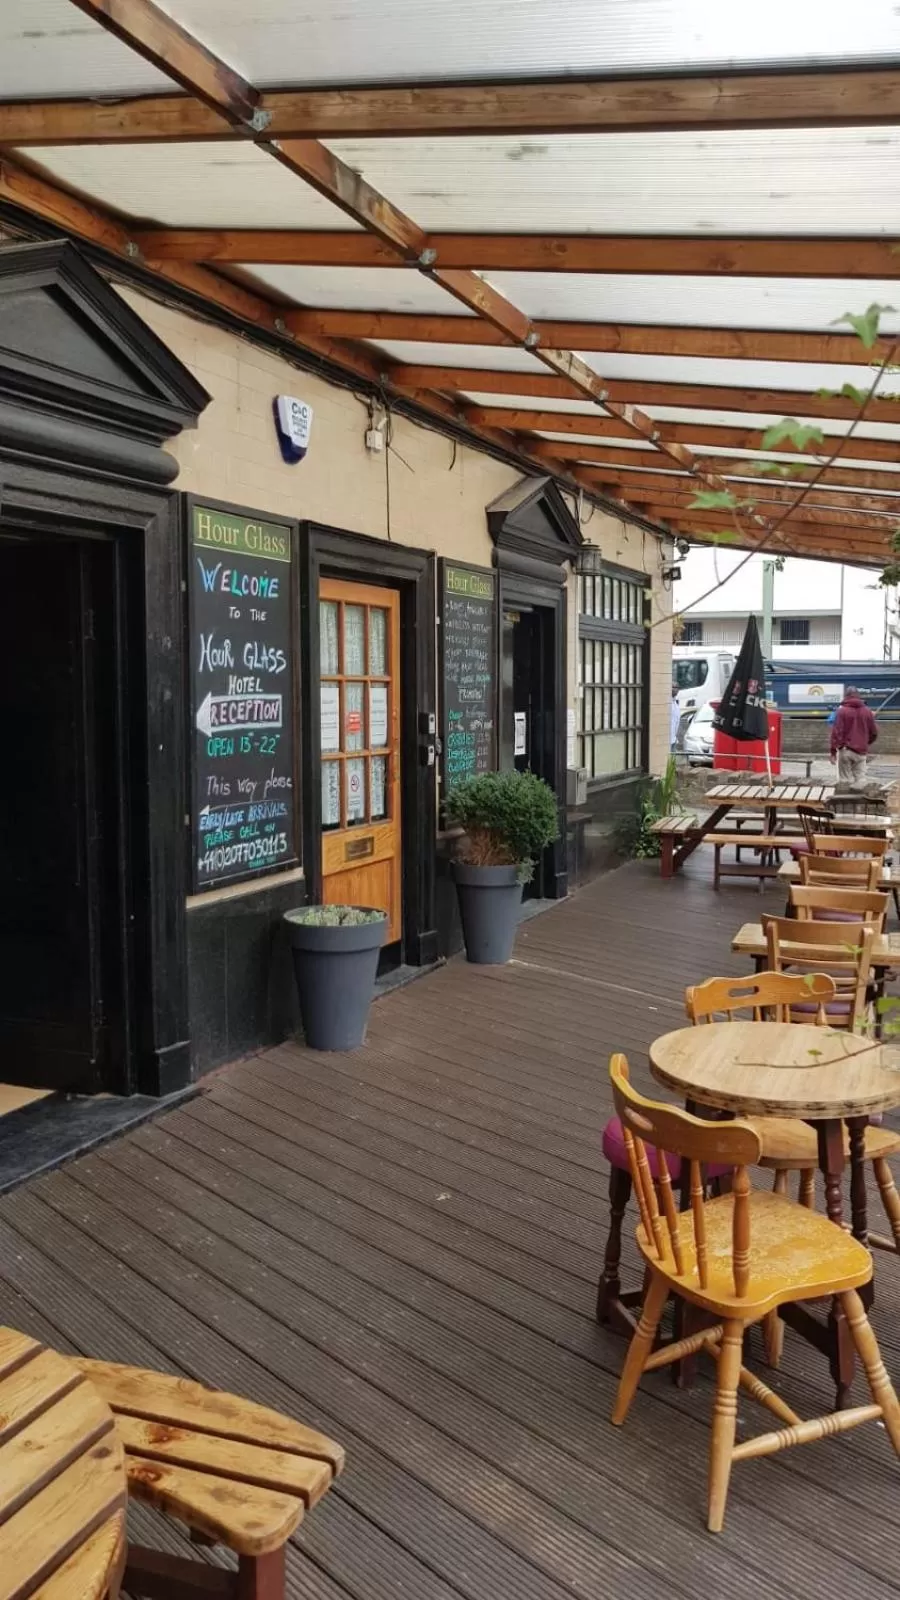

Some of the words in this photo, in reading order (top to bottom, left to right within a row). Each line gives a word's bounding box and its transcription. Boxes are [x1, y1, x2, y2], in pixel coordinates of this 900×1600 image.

[198, 514, 239, 545] Hour
[244, 525, 286, 554] Glass
[197, 557, 280, 598] WELCOME
[447, 570, 468, 592] Hour
[199, 633, 235, 673] HOUR
[243, 642, 287, 674] GLASS
[228, 675, 263, 695] HOTEL
[210, 700, 280, 726] RECEPTION
[207, 737, 234, 757] OPEN
[207, 775, 231, 796] This
[263, 768, 292, 799] please
[248, 801, 288, 821] ARRIVALS
[203, 830, 235, 849] PLEASE
[239, 822, 260, 838] CALL
